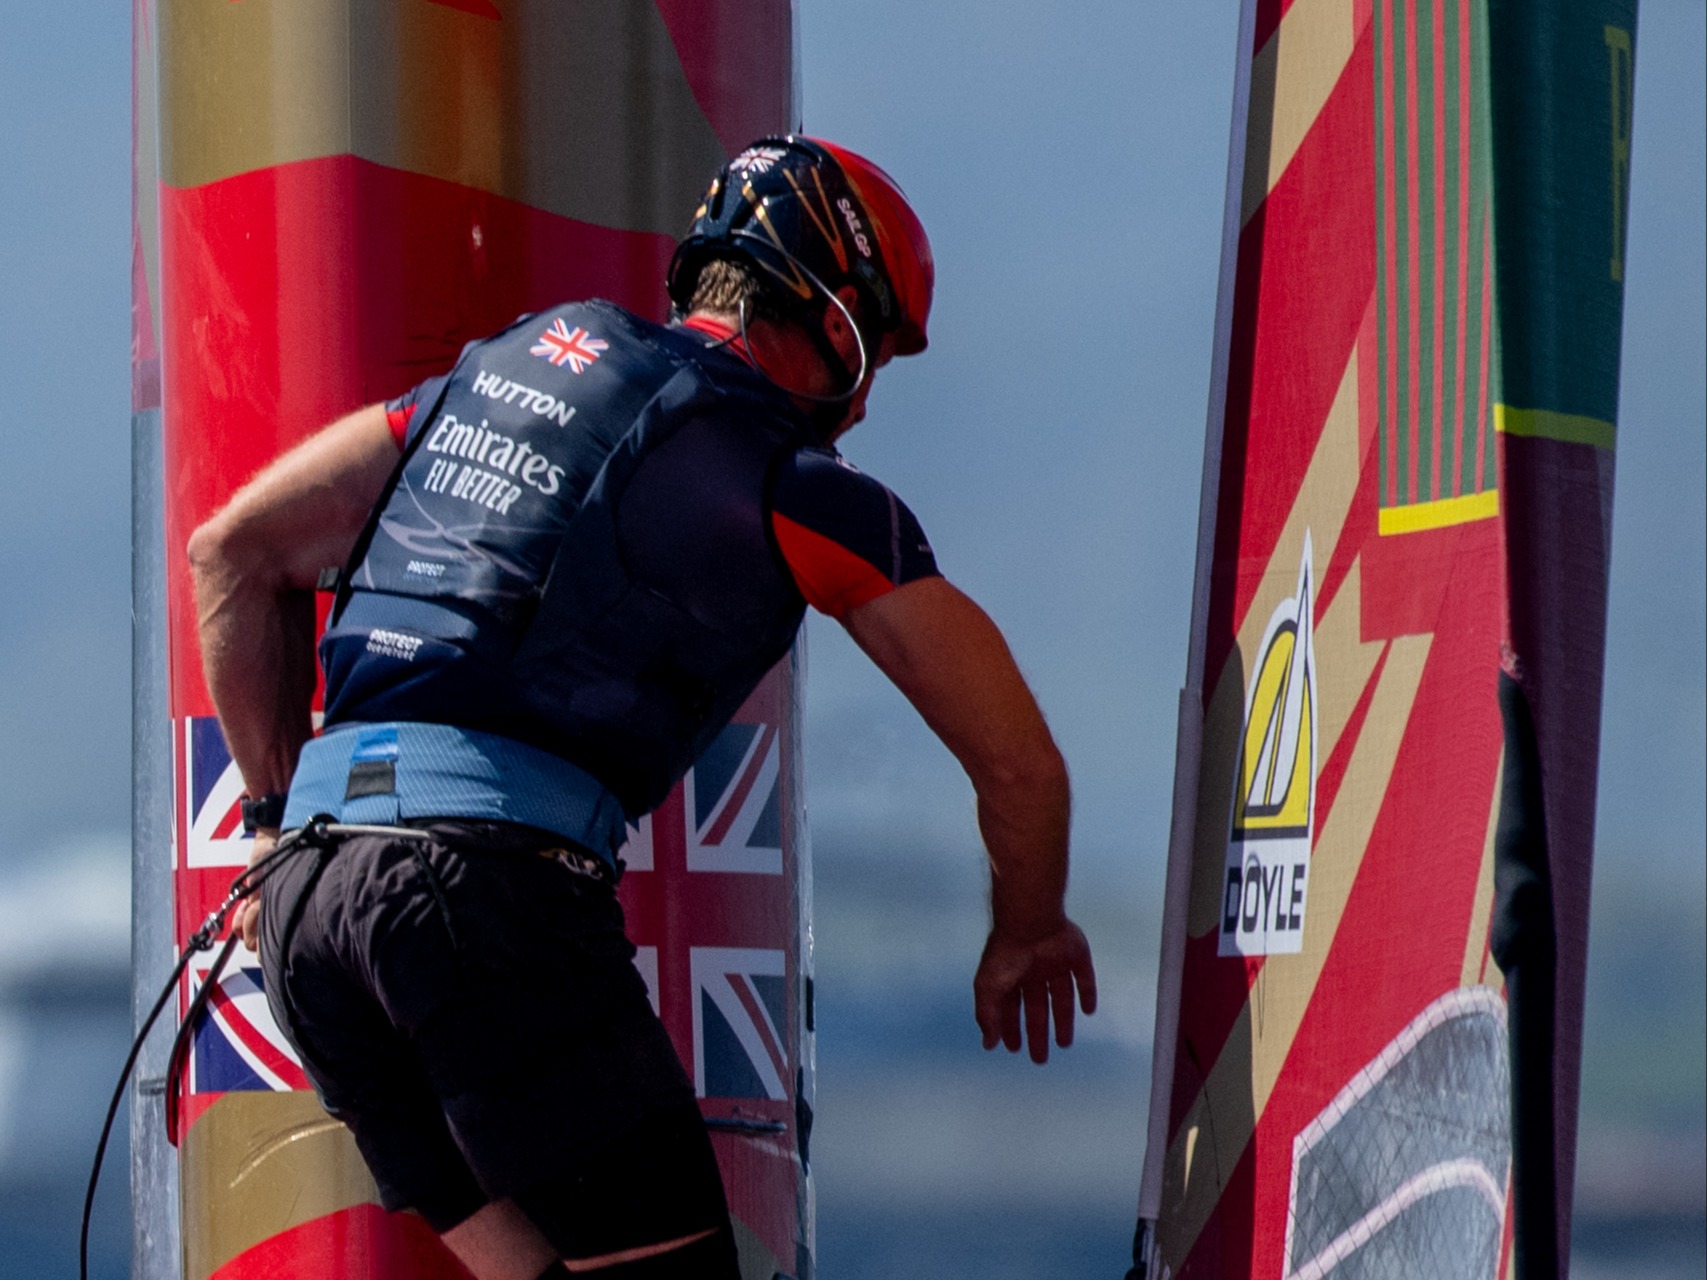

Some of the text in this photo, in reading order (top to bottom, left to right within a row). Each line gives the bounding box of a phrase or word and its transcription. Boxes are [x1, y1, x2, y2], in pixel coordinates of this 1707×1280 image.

[472, 370, 576, 428] HUTTON
[424, 458, 522, 516] FLY BETTER
[427, 414, 566, 496] Emirates
[1223, 864, 1306, 935] DOYLE
